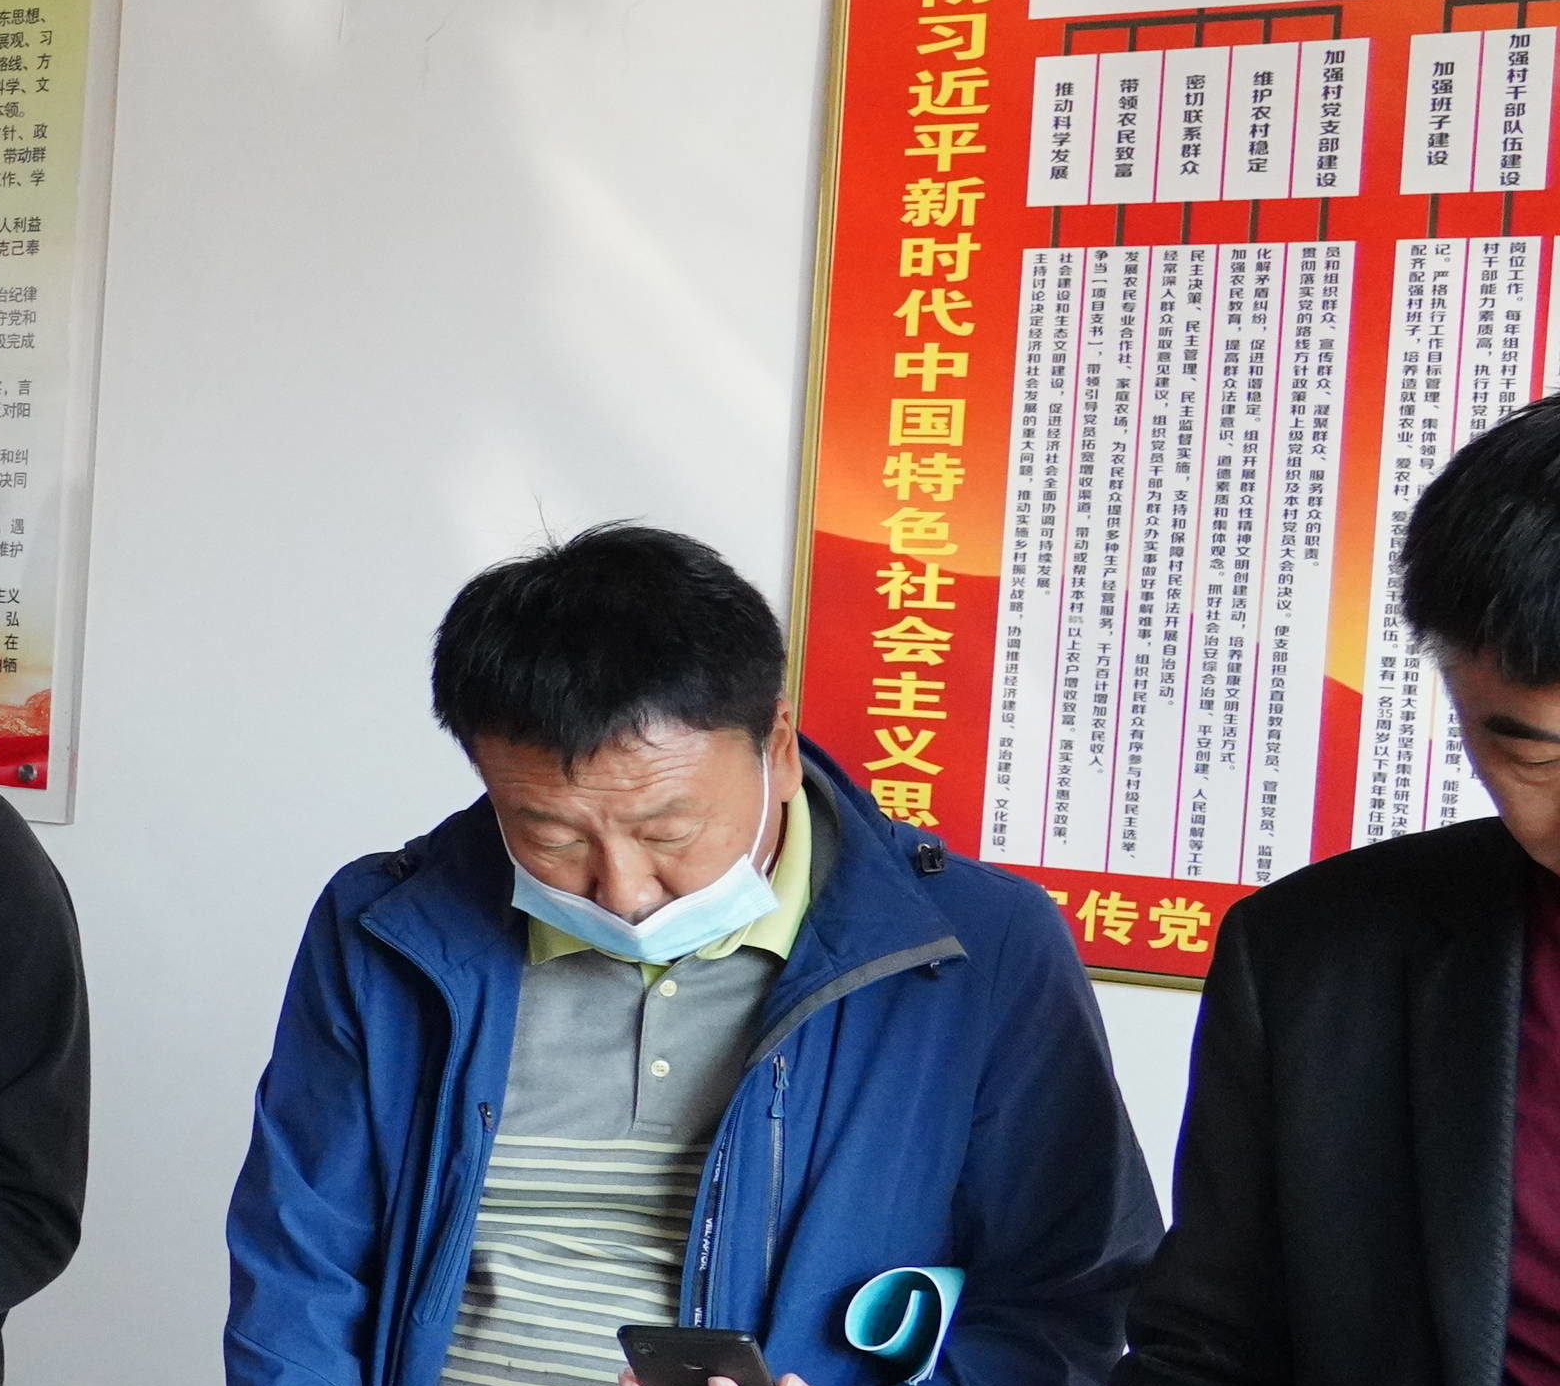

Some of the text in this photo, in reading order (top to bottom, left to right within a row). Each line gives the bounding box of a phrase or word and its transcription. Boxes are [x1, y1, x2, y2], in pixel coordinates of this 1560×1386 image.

[1049, 81, 1074, 182] 推动科学发展
[1114, 77, 1140, 179] 带领农民致富
[1179, 73, 1206, 177] 密切联系群众
[1246, 69, 1274, 175] 维护农村稳定
[1314, 49, 1346, 189] 加强村党支部建设
[1425, 60, 1456, 167] 加强班子建设
[1498, 33, 1531, 189] 加强村干部队伍建设
[1304, 246, 1341, 570] 员和组织群众、宣传群众、凝聚群众、服务群众的职责。
